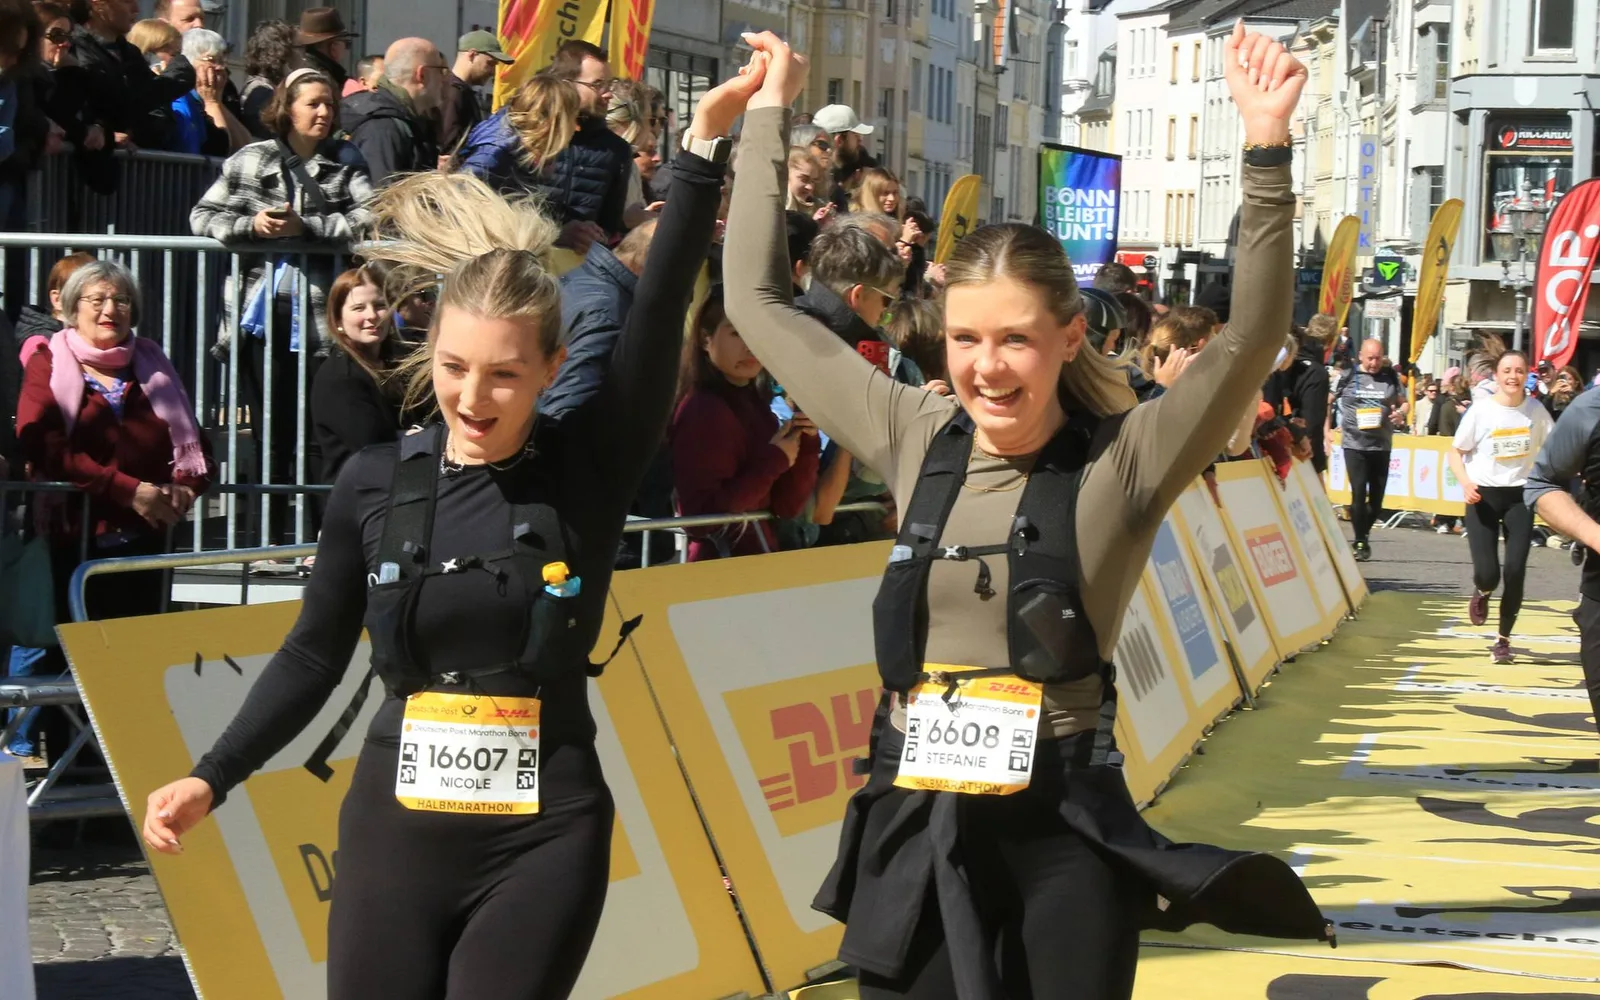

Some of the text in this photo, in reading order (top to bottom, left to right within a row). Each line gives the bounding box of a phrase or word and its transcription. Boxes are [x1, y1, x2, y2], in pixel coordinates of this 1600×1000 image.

[1045, 186, 1115, 207] BONN
[1359, 142, 1376, 247] OPTIK
[989, 682, 1032, 696] DHL
[407, 705, 458, 716] Deutsche Post
[494, 707, 533, 718] DHL
[1002, 706, 1024, 717] Bonn
[414, 724, 528, 738] Deutsche Post Marathon Bonn
[428, 744, 509, 772] 16607
[926, 751, 988, 769] STEFANIE
[440, 776, 492, 790] NICOLE
[914, 777, 1002, 794] HALBMARATHON
[416, 799, 514, 813] HALBMARATHON
[297, 842, 338, 903] D
[1325, 917, 1600, 945] eutsche
